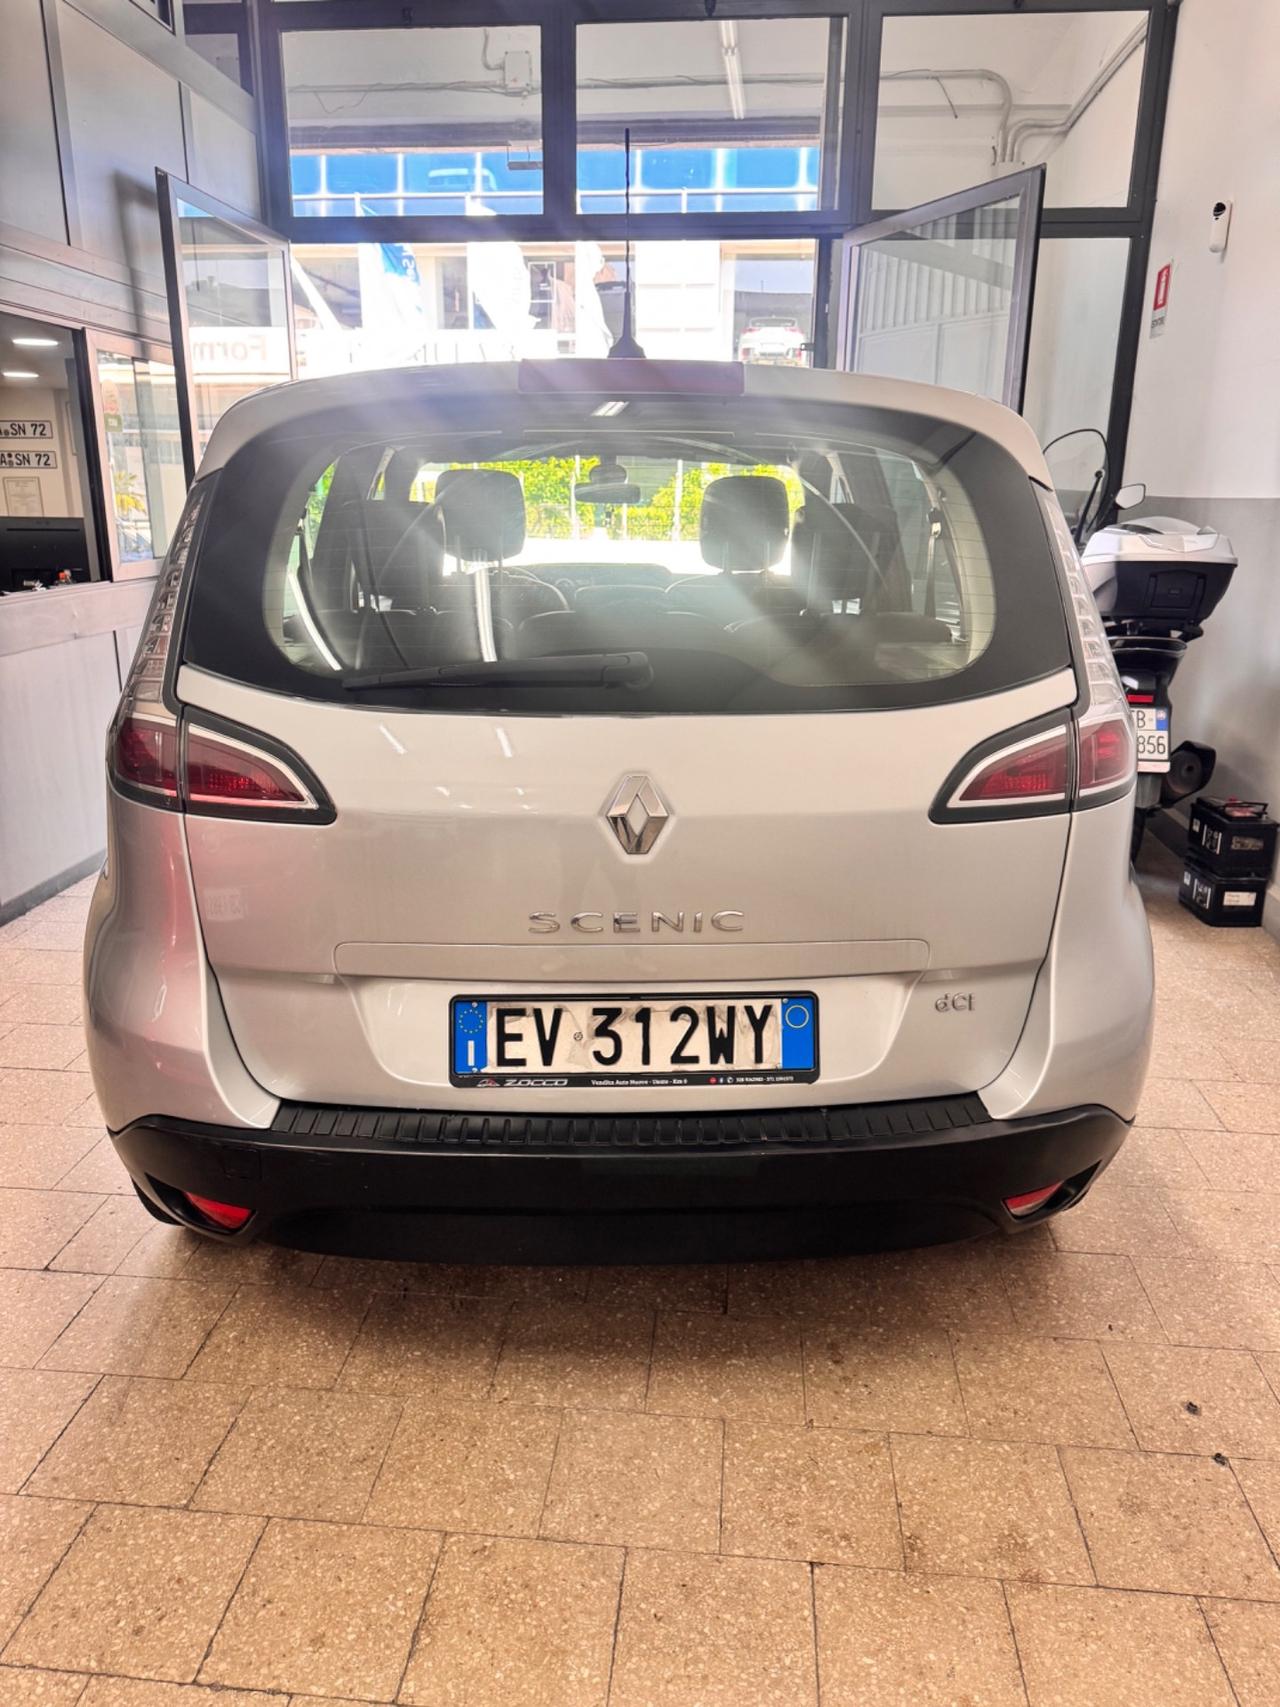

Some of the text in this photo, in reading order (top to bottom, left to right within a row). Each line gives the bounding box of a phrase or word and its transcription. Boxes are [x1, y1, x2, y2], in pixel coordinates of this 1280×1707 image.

[10, 423, 47, 436] SN 72
[14, 453, 31, 466] SN
[35, 453, 51, 466] 72
[1137, 735, 1166, 754] 856
[528, 910, 745, 933] SCENIC
[496, 1007, 564, 1067] EV
[592, 1005, 773, 1066] 312WY
[503, 1078, 568, 1087] ZOCCO
